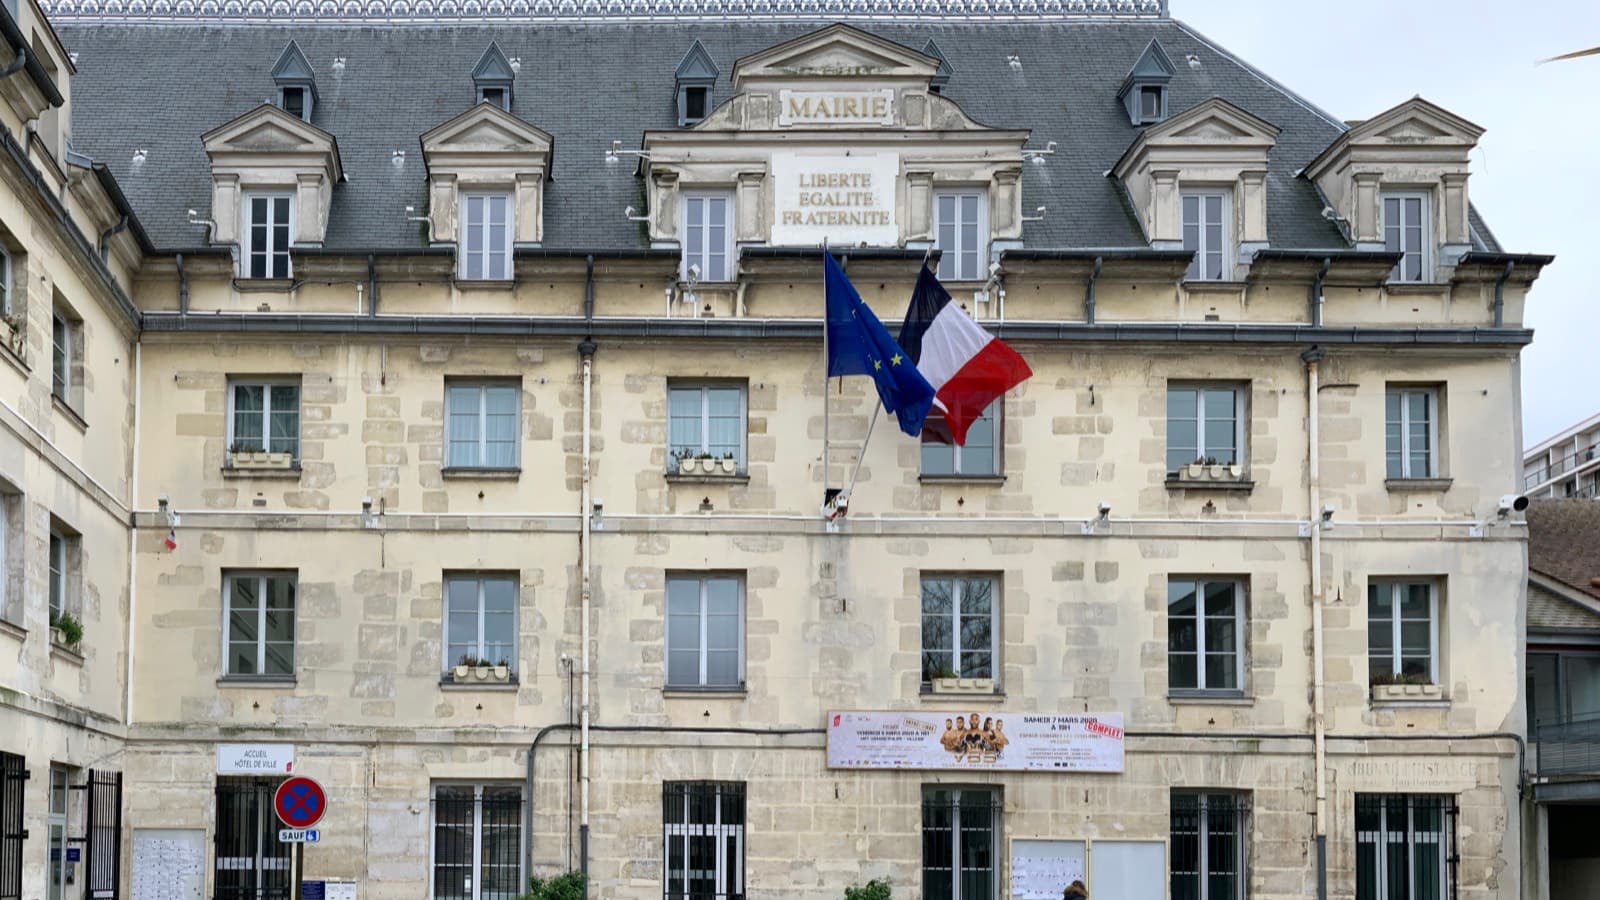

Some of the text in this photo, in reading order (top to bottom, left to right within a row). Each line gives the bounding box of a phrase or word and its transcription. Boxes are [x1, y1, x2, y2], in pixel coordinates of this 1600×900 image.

[788, 96, 888, 118] MAIRIE
[799, 173, 871, 188] LIBERTE
[799, 192, 874, 206] EGALITE
[782, 211, 890, 225] FRATERNITE
[1087, 721, 1121, 737] COMPLET
[244, 750, 267, 758] ACCUEIL
[234, 759, 277, 768] HÔTEL DE VILLE
[282, 831, 305, 840] SAUF
